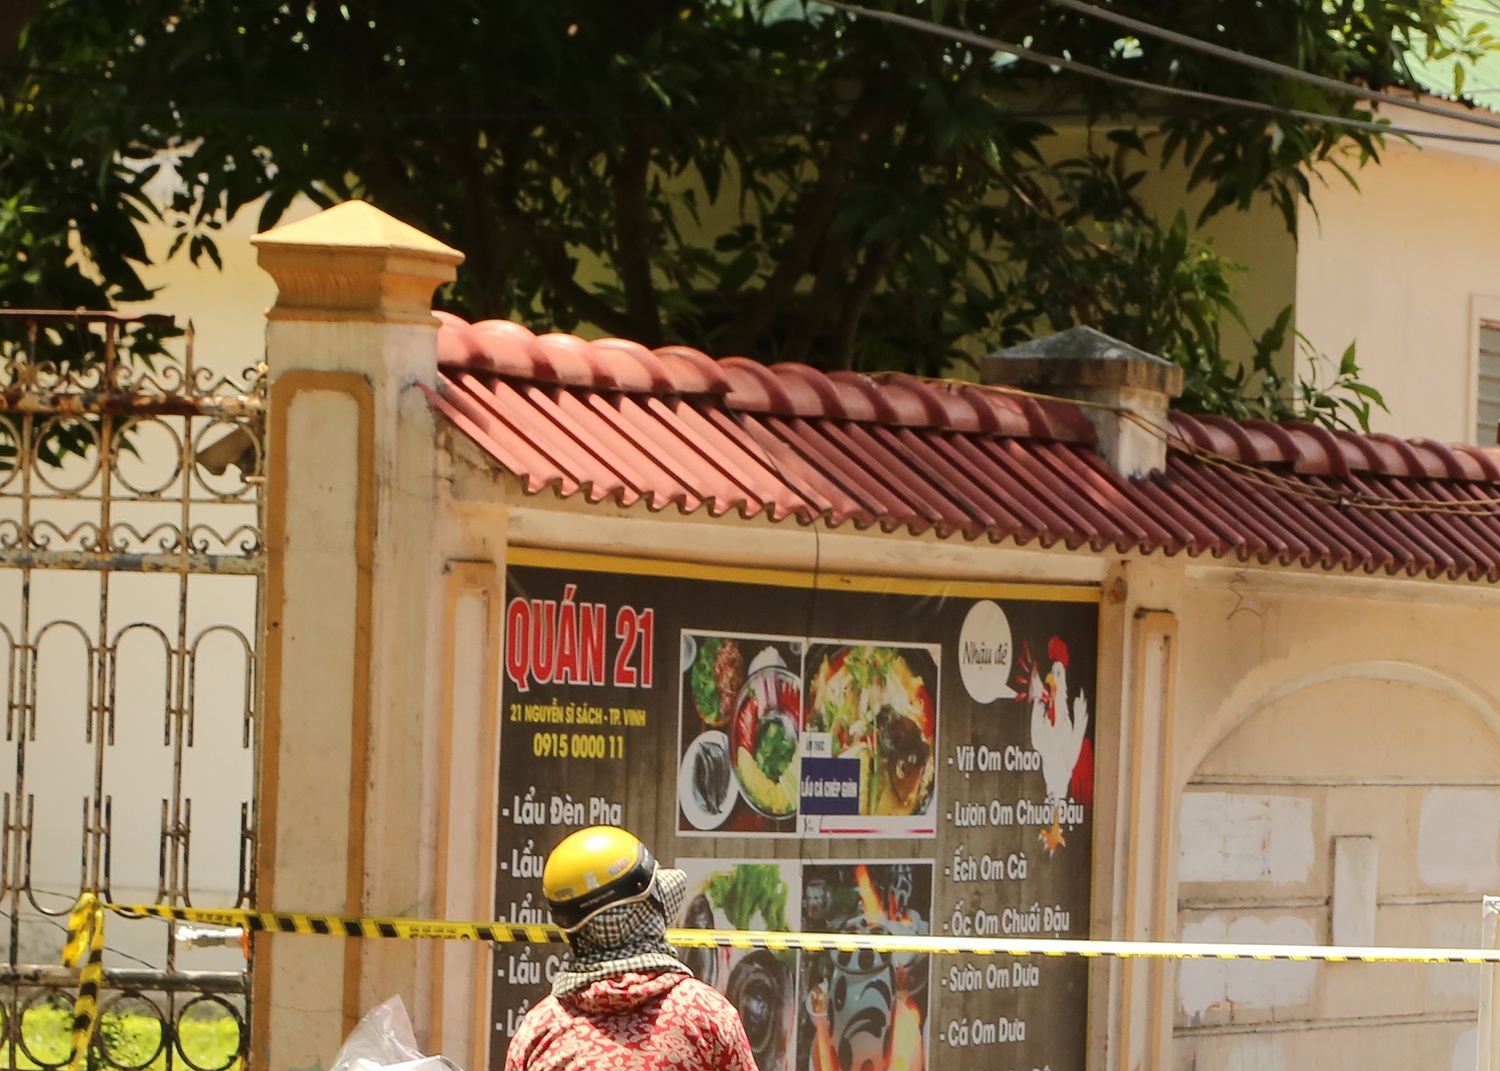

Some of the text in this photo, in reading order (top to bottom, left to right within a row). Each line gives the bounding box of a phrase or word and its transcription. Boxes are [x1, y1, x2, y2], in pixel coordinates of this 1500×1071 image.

[506, 584, 654, 692] QUÁN 21
[533, 732, 624, 759] 0915 0000 11
[977, 746, 1001, 771] Om
[1004, 746, 1041, 771] Chao
[513, 786, 622, 826] Lẩu Đèn Pha
[989, 801, 1013, 825] Om
[511, 839, 543, 878] Lẩu
[980, 854, 1004, 880] Om
[974, 908, 999, 935] Om
[508, 946, 540, 984] Lẩu
[985, 964, 1010, 990] Om
[971, 1020, 996, 1046] Om
